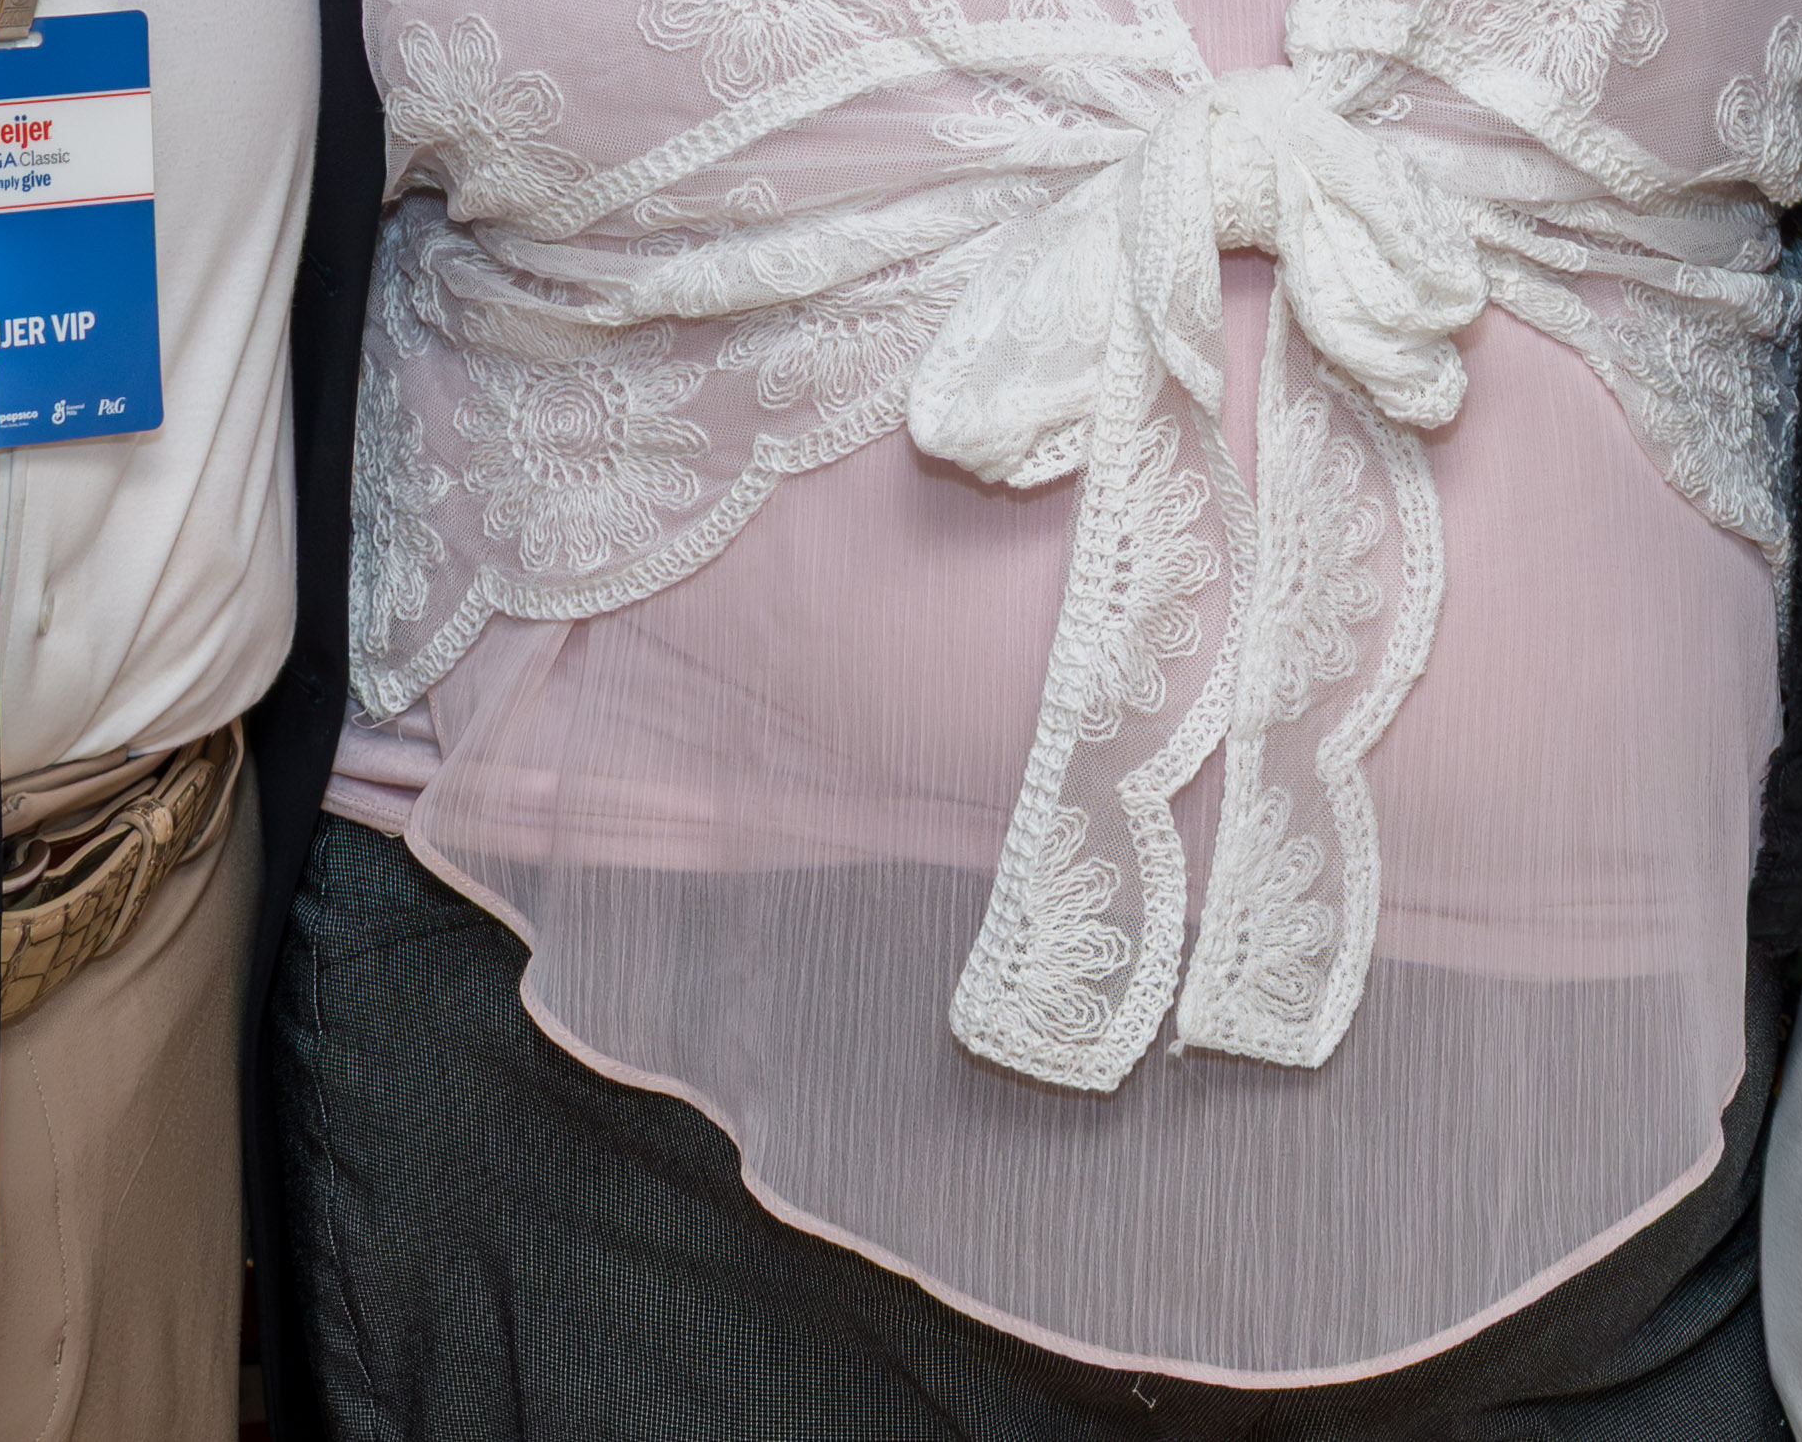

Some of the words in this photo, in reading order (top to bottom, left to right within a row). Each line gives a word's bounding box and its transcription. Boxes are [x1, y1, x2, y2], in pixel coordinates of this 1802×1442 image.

[19, 148, 71, 166] Classic
[22, 170, 52, 193] give
[50, 310, 97, 343] VIP
[98, 396, 127, 416] P&G
